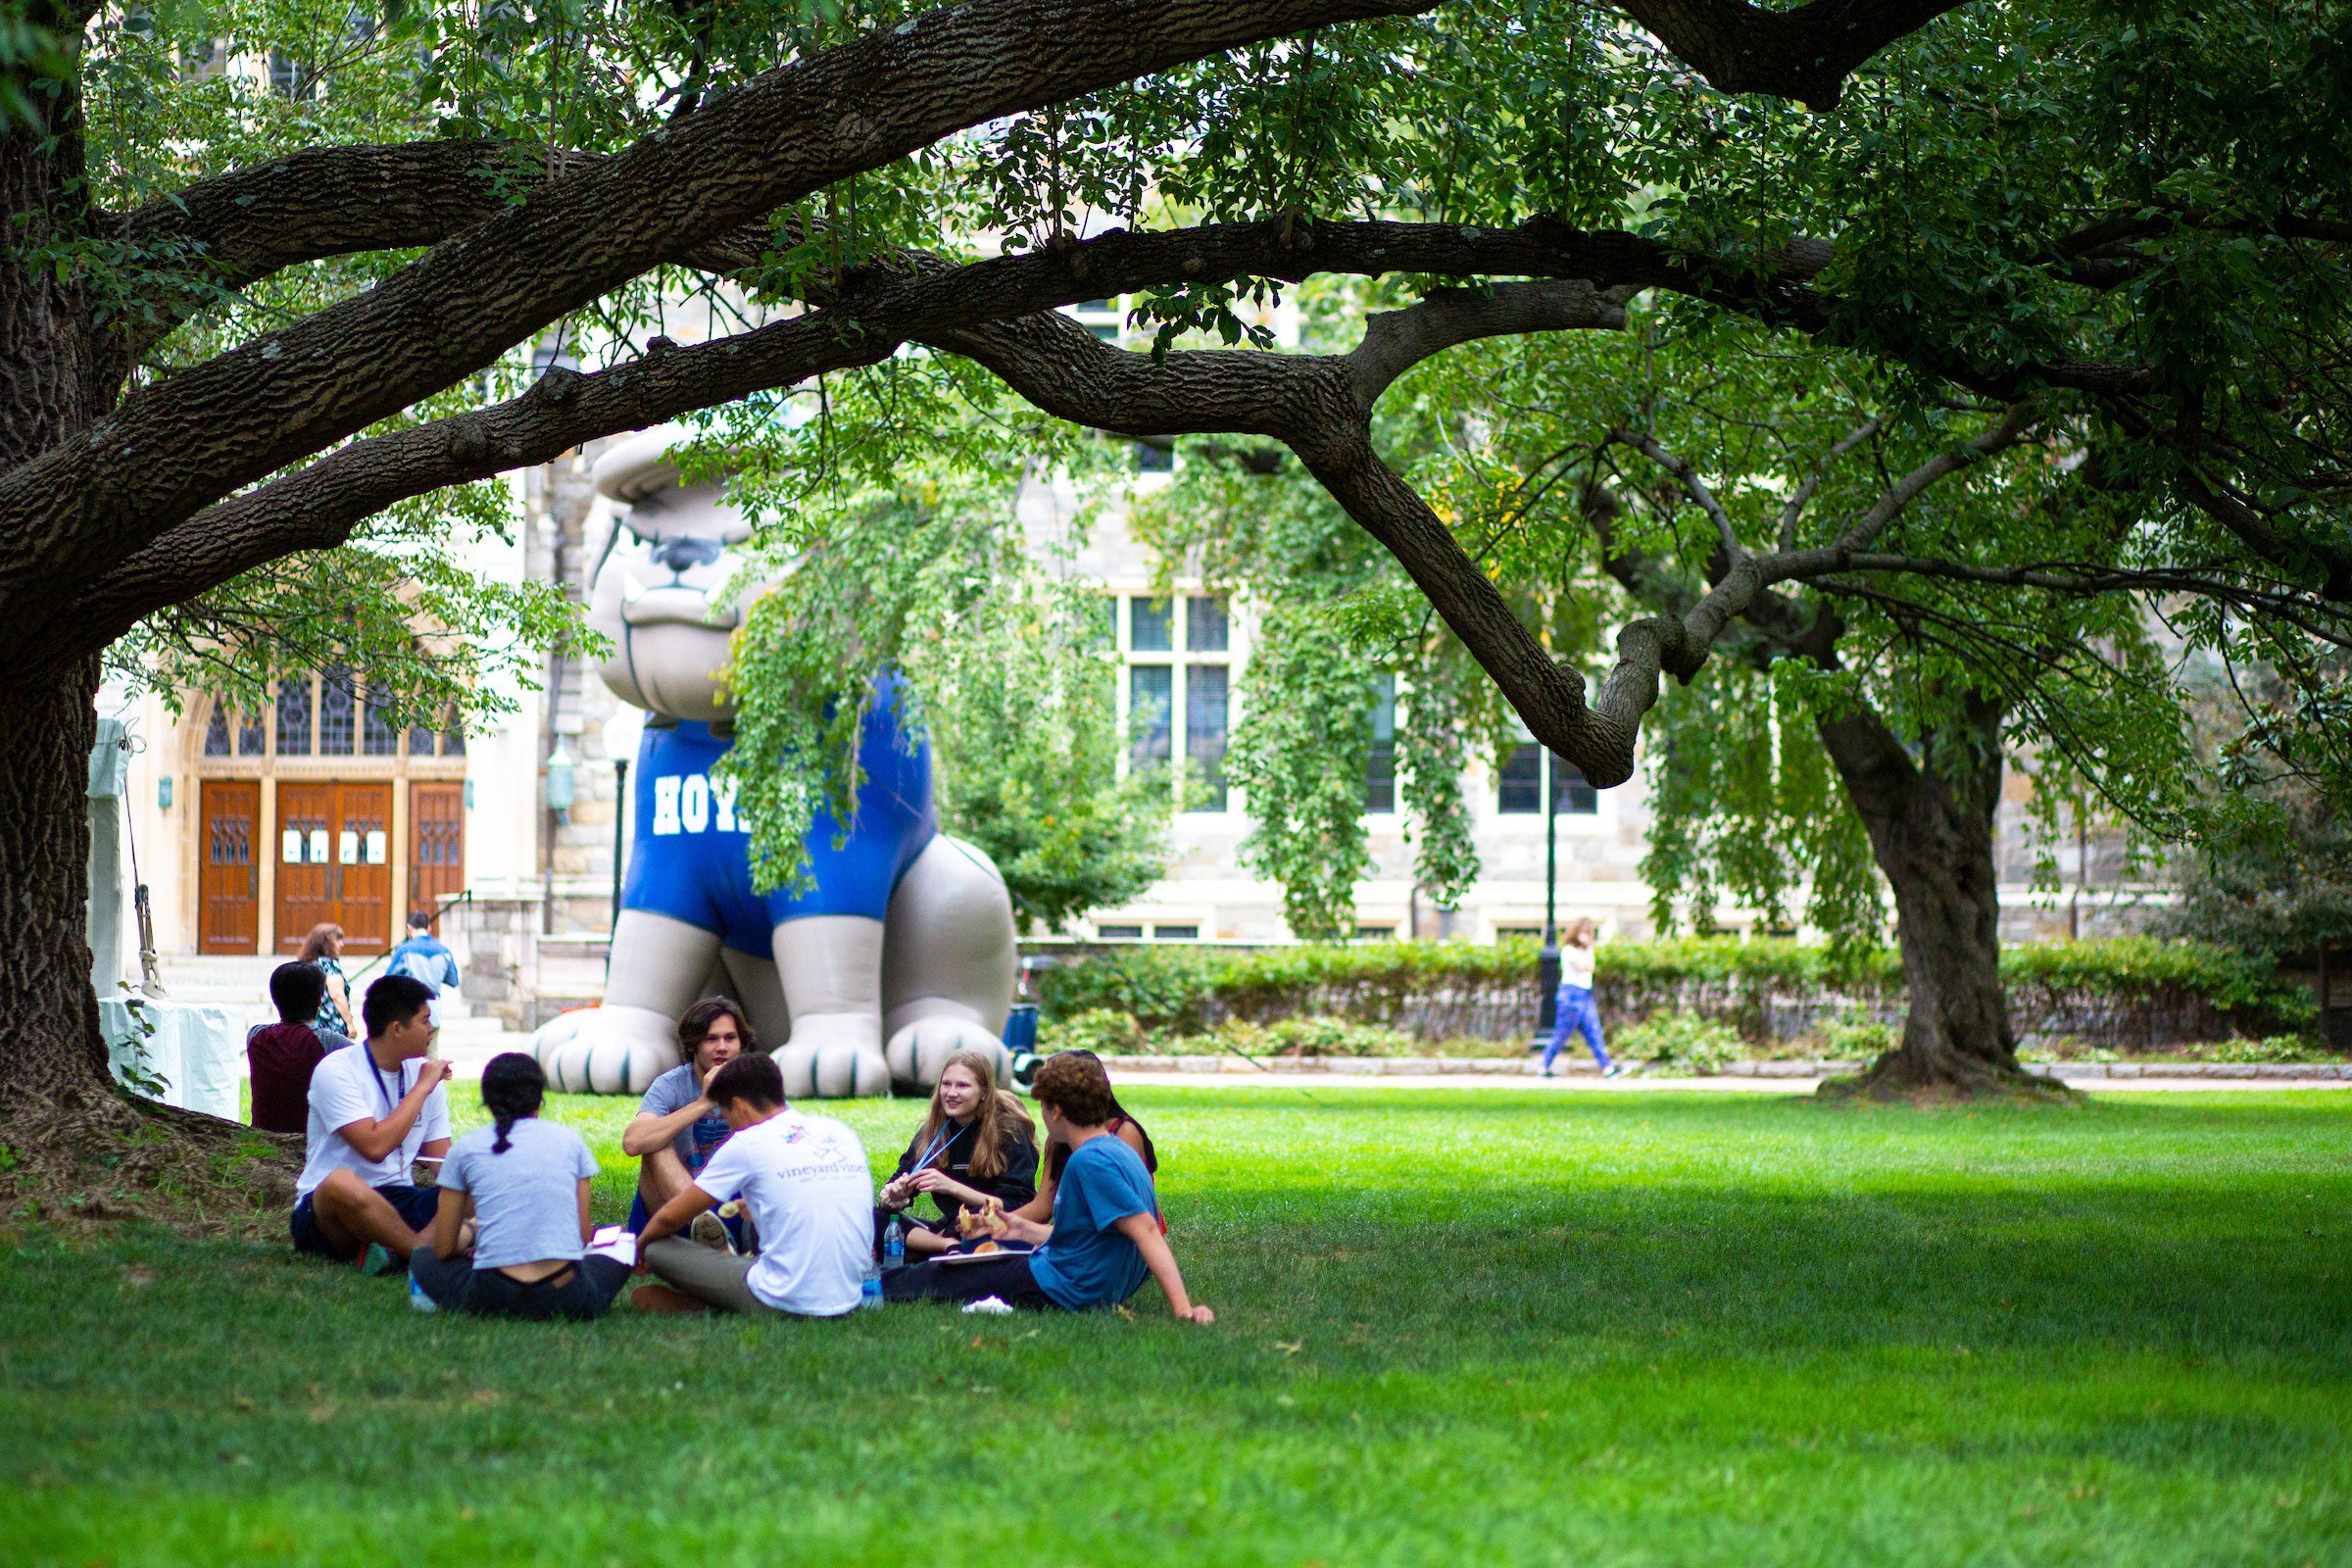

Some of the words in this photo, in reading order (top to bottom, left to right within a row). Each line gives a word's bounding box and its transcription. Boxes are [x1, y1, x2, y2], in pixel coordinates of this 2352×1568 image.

[653, 773, 752, 836] HOY
[777, 1161, 839, 1179] vineyard
[840, 1162, 867, 1174] vine
